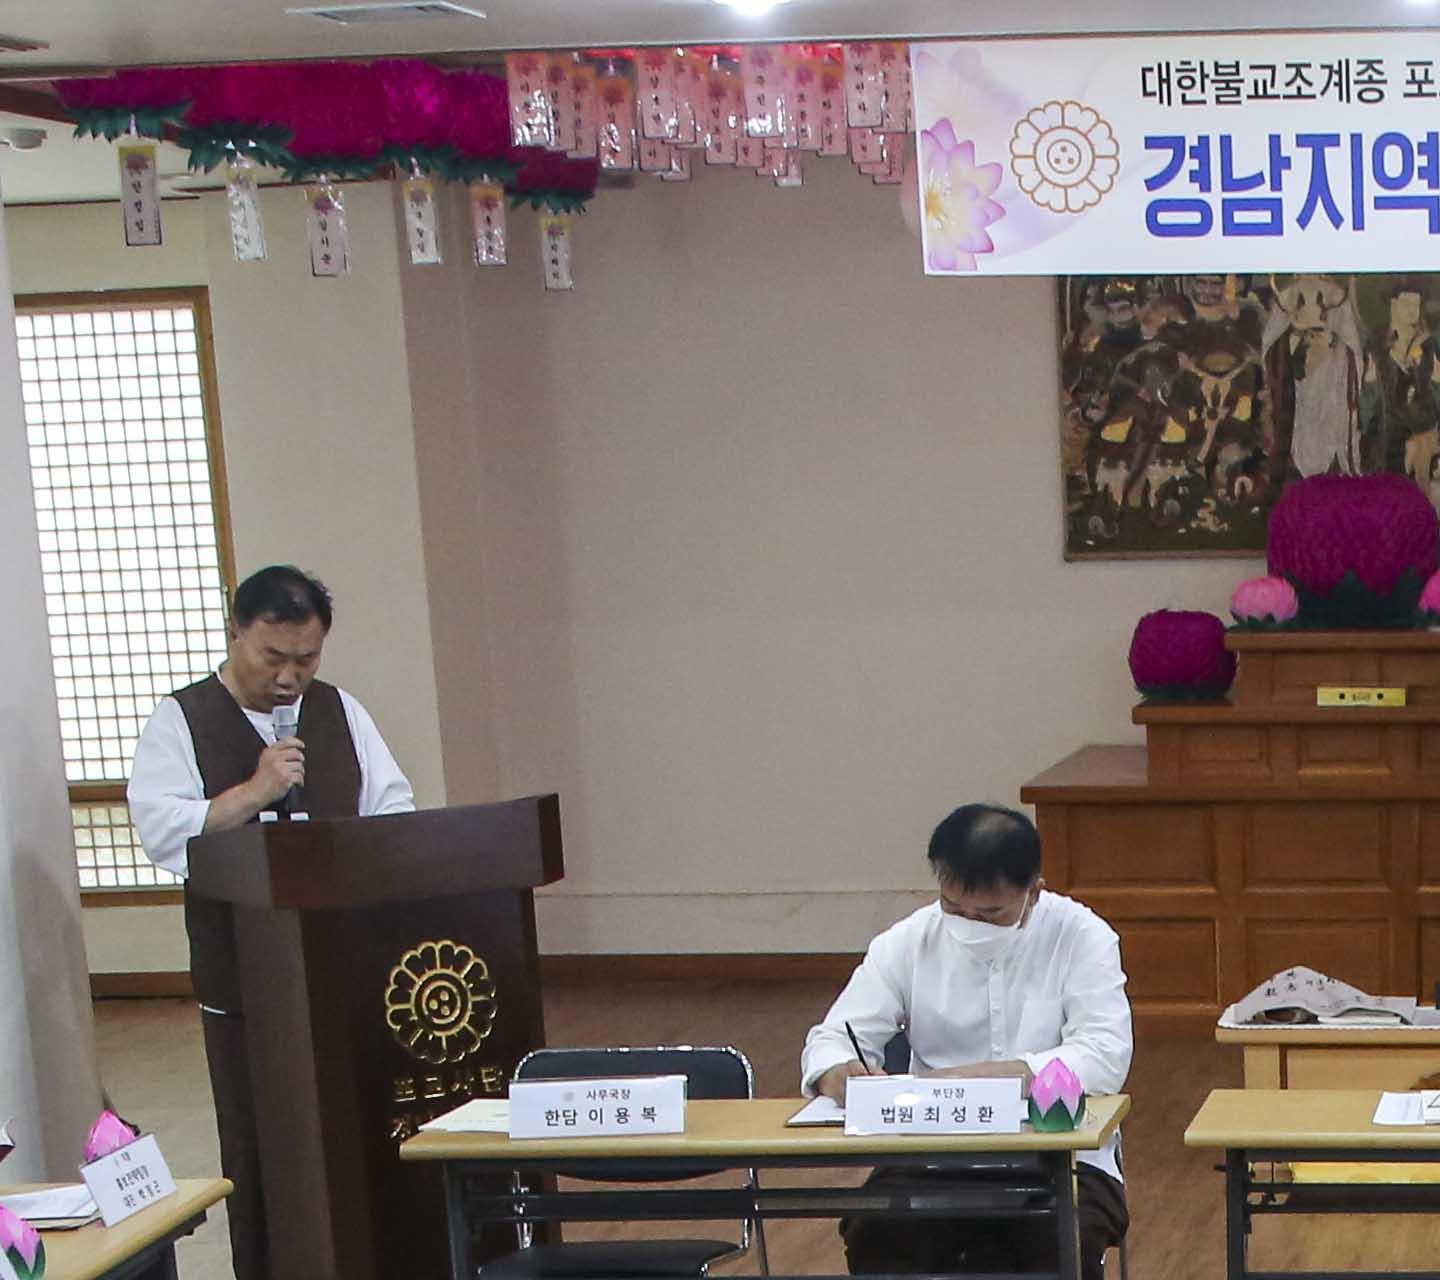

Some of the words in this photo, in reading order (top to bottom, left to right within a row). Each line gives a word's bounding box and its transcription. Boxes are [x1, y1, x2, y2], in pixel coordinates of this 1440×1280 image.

[1141, 58, 1387, 107] 대한불교조계종
[586, 1089, 630, 1101] 사무국장
[933, 1088, 965, 1099] 부단장
[545, 1109, 578, 1126] 한담
[589, 1108, 603, 1125] 이
[615, 1107, 630, 1124] 용
[641, 1106, 656, 1123] 복
[924, 1106, 939, 1123] 최
[951, 1106, 966, 1123] 성
[977, 1106, 994, 1123] 환
